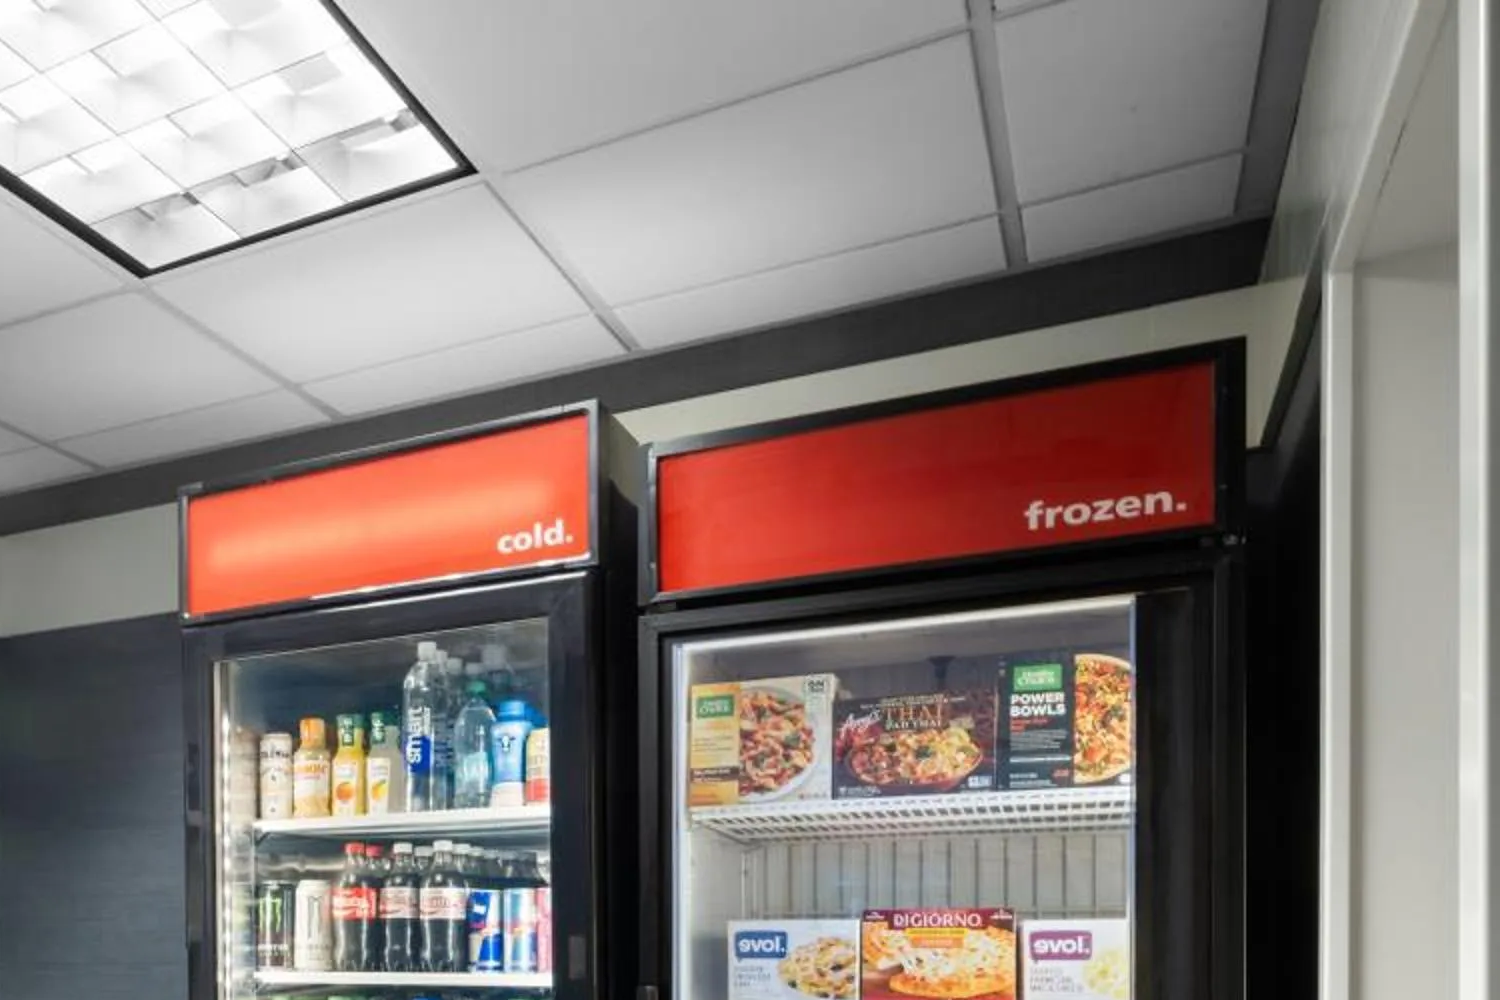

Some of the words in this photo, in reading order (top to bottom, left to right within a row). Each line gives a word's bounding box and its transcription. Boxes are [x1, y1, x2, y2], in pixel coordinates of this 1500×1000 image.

[1023, 490, 1188, 531] frozen.
[496, 518, 574, 554] cold.
[1010, 691, 1065, 705] POWER
[1009, 703, 1067, 717] BOWLS
[893, 912, 983, 928] DIGIORNO
